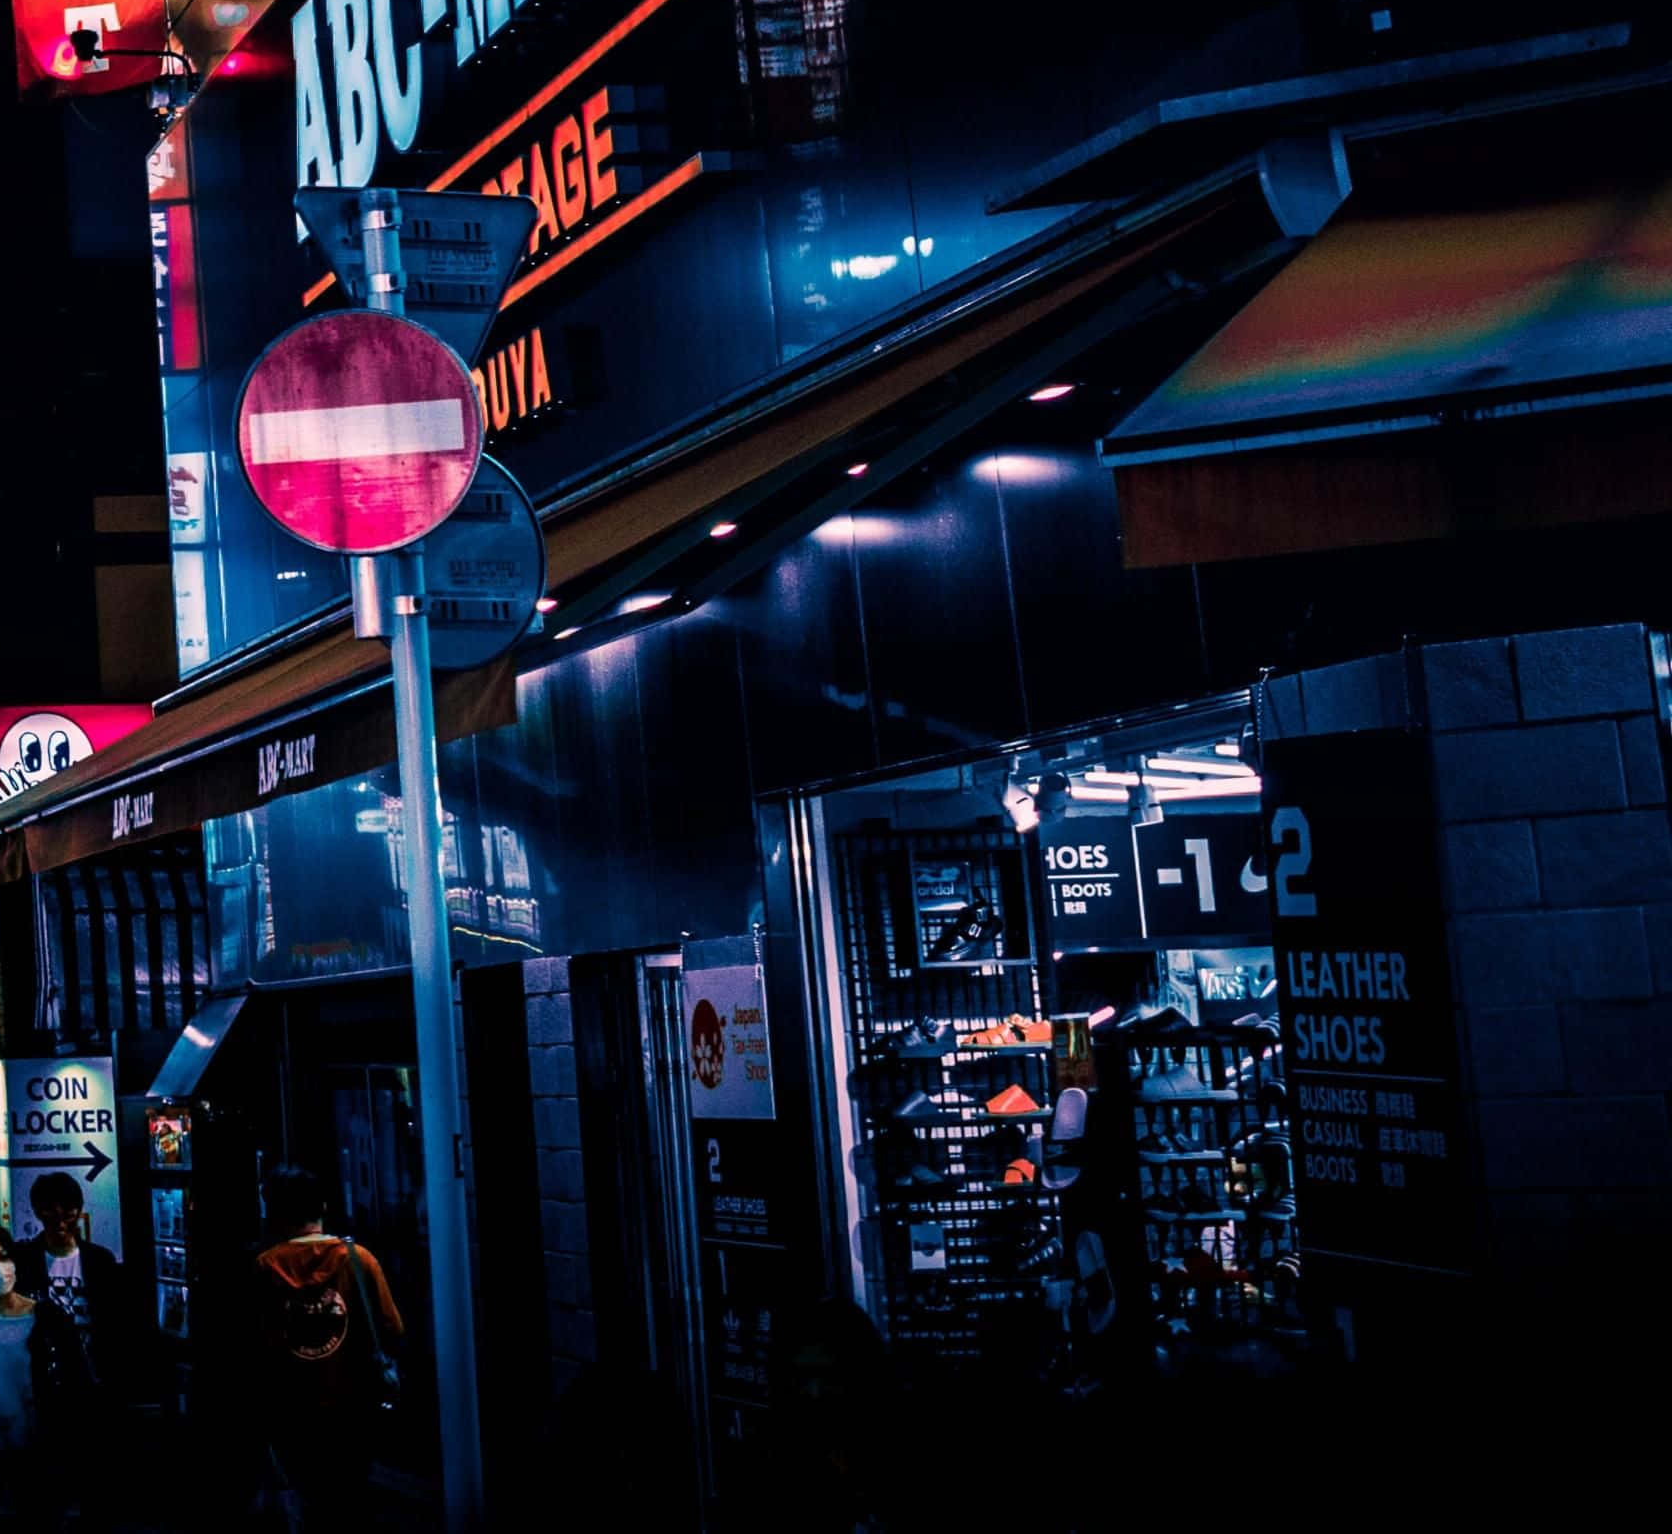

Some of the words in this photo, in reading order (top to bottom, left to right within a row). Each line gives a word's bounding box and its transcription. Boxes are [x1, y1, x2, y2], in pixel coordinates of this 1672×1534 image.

[481, 86, 618, 255] AGE
[258, 736, 316, 794] ABC-MART
[112, 794, 153, 839] ABC-MART
[1044, 844, 1110, 871] HOES
[1270, 806, 1320, 919] 2
[1061, 883, 1113, 897] BOOTS
[1287, 950, 1410, 1002] LEATHER
[1294, 1012, 1384, 1066] SHOES
[27, 1078, 88, 1101] COIN
[1298, 1085, 1368, 1116] BUSINESS
[13, 1110, 113, 1135] LOCKER
[1303, 1118, 1363, 1151] CASUAL
[1304, 1153, 1360, 1185] BOOTS
